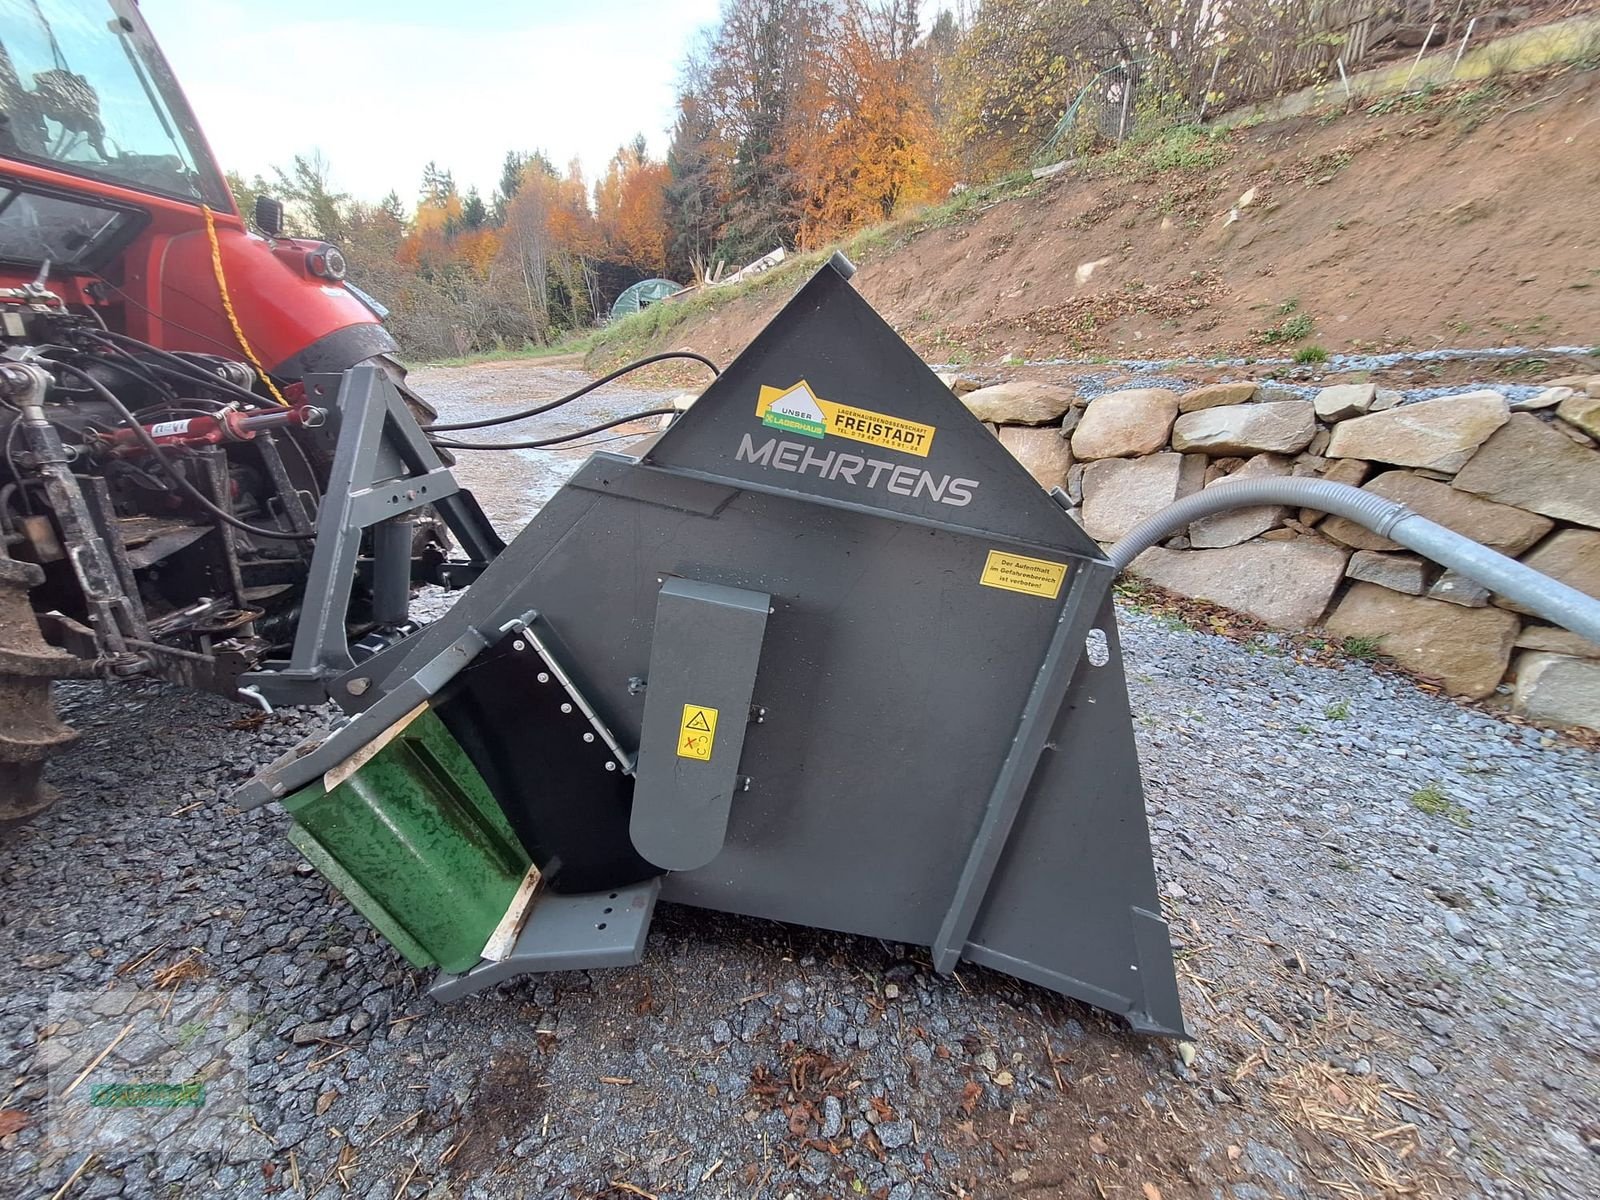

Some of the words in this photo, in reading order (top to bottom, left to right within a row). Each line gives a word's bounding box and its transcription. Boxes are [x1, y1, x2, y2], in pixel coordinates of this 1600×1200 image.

[782, 408, 812, 419] UNSER
[837, 408, 927, 434] LAGERHAUSGENOSSENSCHAFT
[774, 417, 822, 434] LAGERHAUS
[835, 414, 925, 446] FREISTADT
[735, 433, 980, 507] MEHRTENS
[1000, 568, 1056, 584] Gefahrenbereich
[1015, 562, 1050, 574] Aufenthalt
[1010, 579, 1042, 588] verboten!
